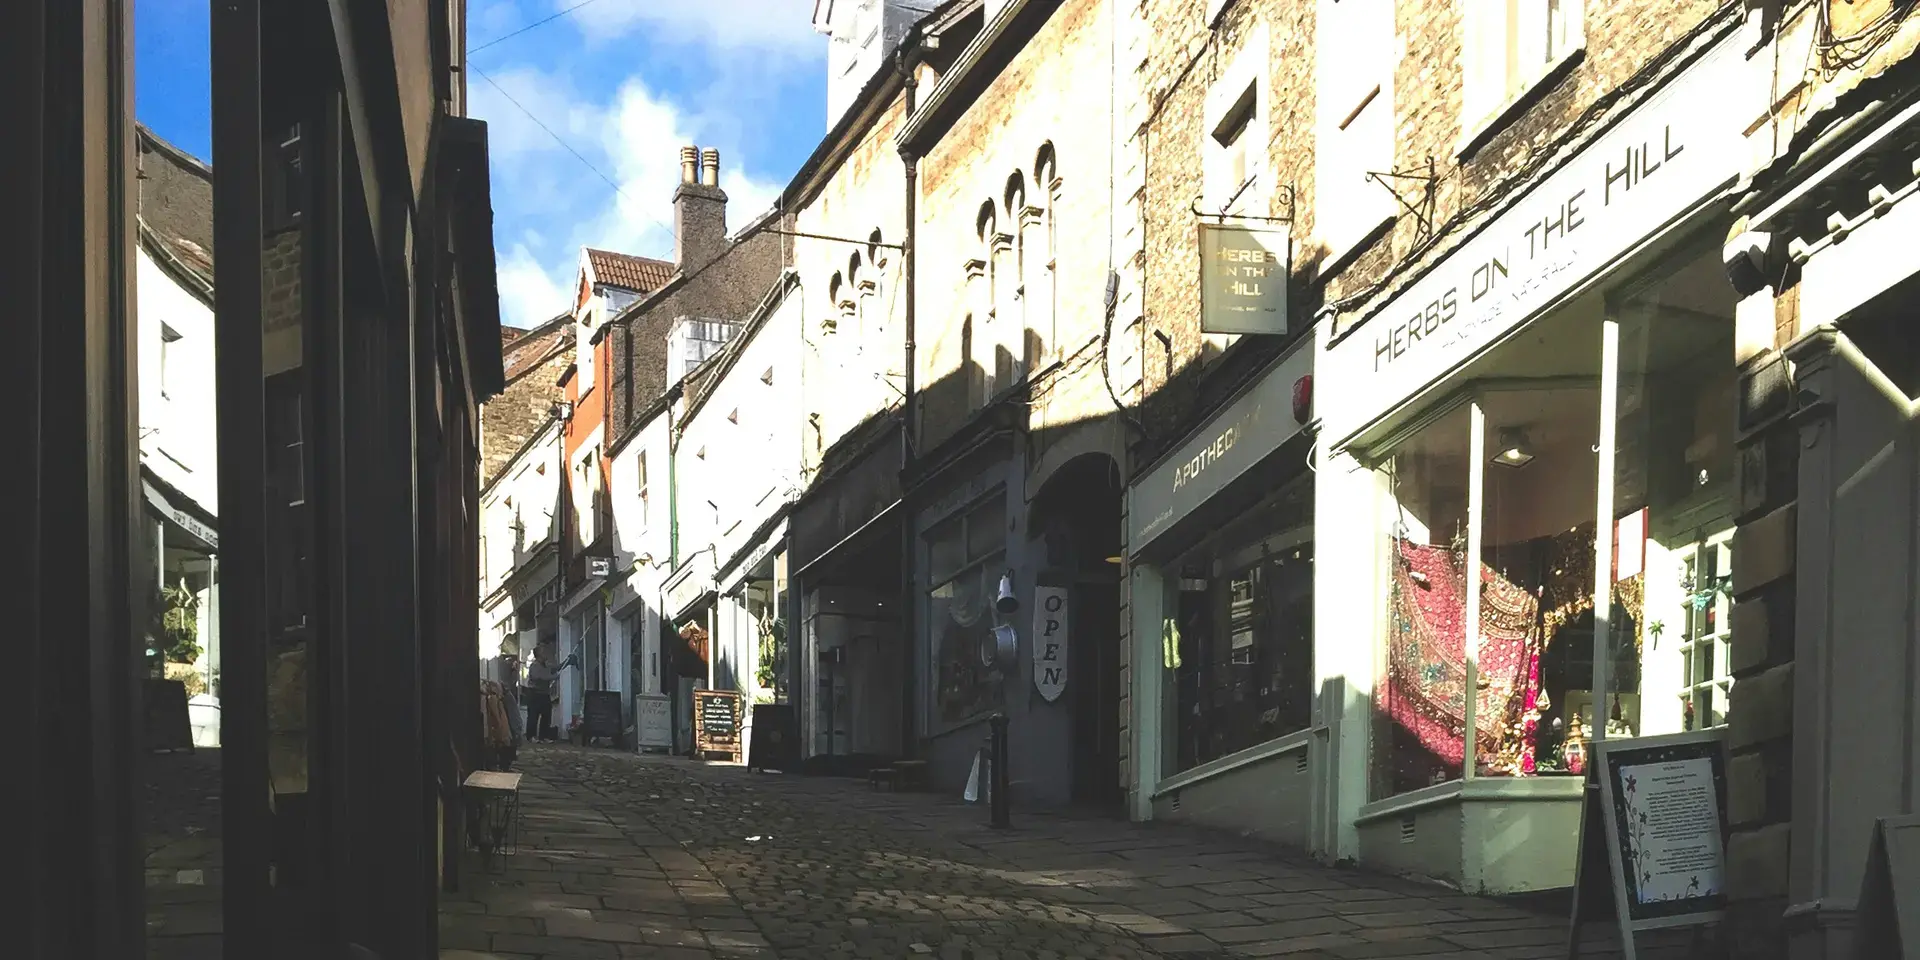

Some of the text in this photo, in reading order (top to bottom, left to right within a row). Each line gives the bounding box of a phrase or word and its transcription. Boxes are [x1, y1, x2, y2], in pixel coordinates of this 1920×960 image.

[1216, 246, 1277, 264] HERBS
[1374, 124, 1685, 373] HERBS ON THE HILL
[1172, 402, 1263, 494] APOTHECA
[1042, 595, 1066, 686] OPEN
